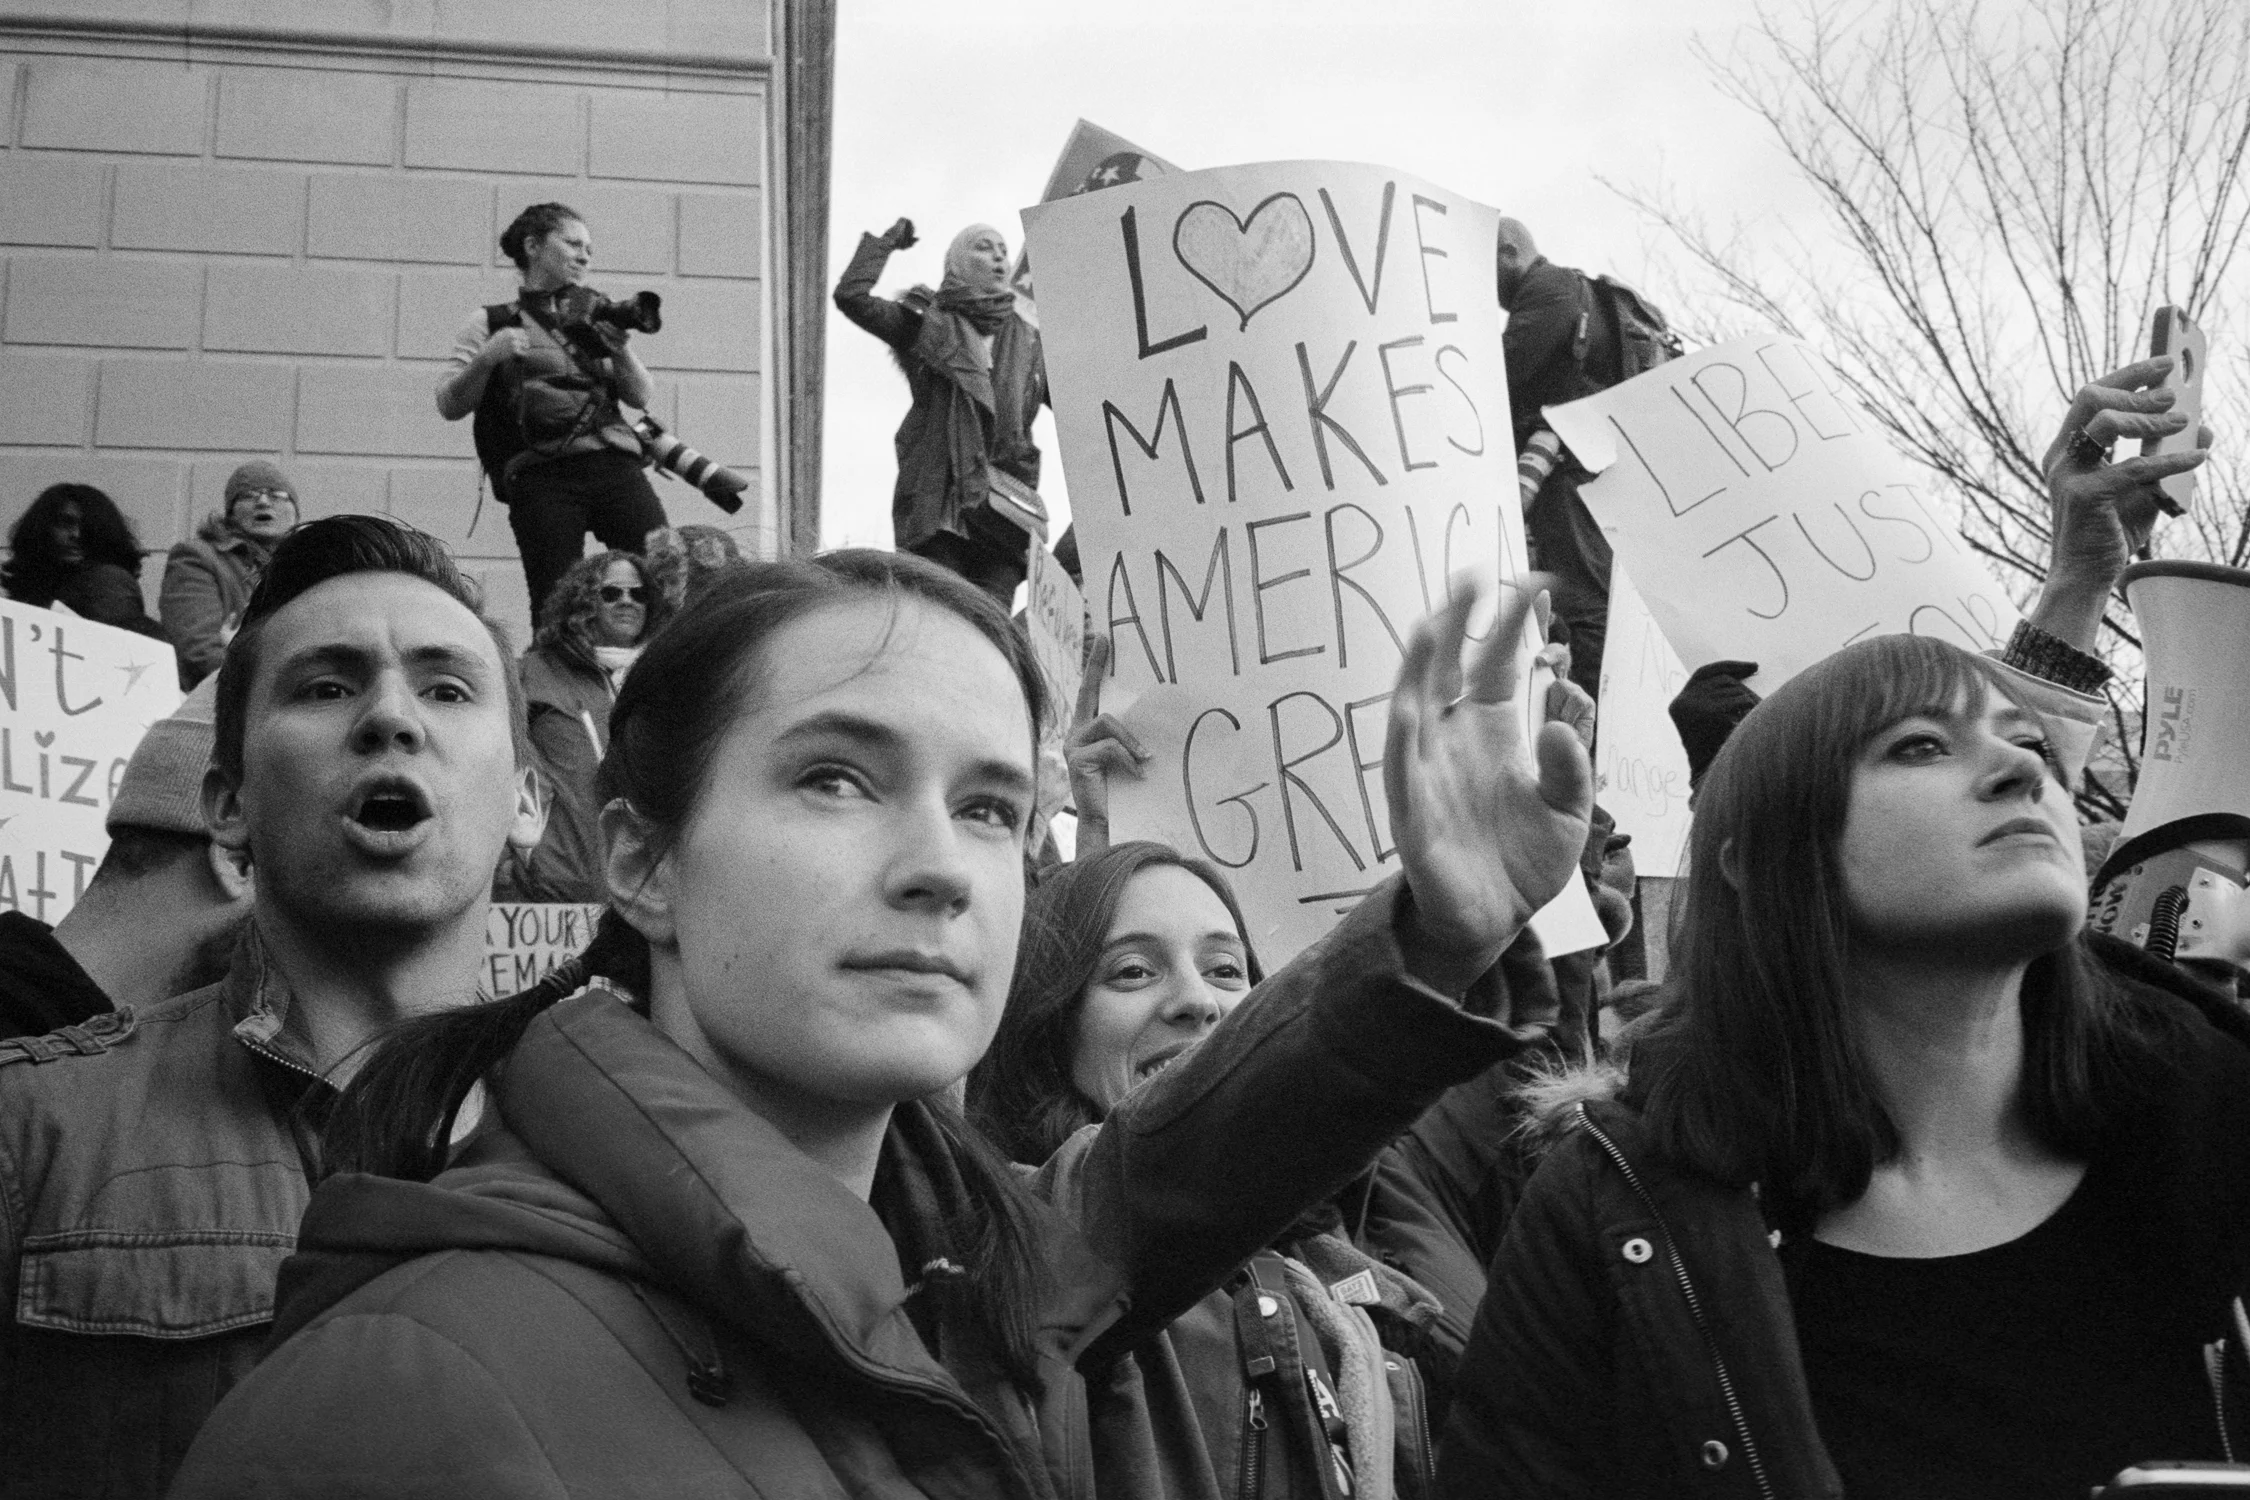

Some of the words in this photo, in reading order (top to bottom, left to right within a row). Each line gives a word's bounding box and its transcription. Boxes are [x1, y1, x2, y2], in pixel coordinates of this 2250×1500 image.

[1102, 335, 1484, 516] MAKES
[2153, 686, 2183, 761] PYLE
[501, 906, 577, 949] YOUR
